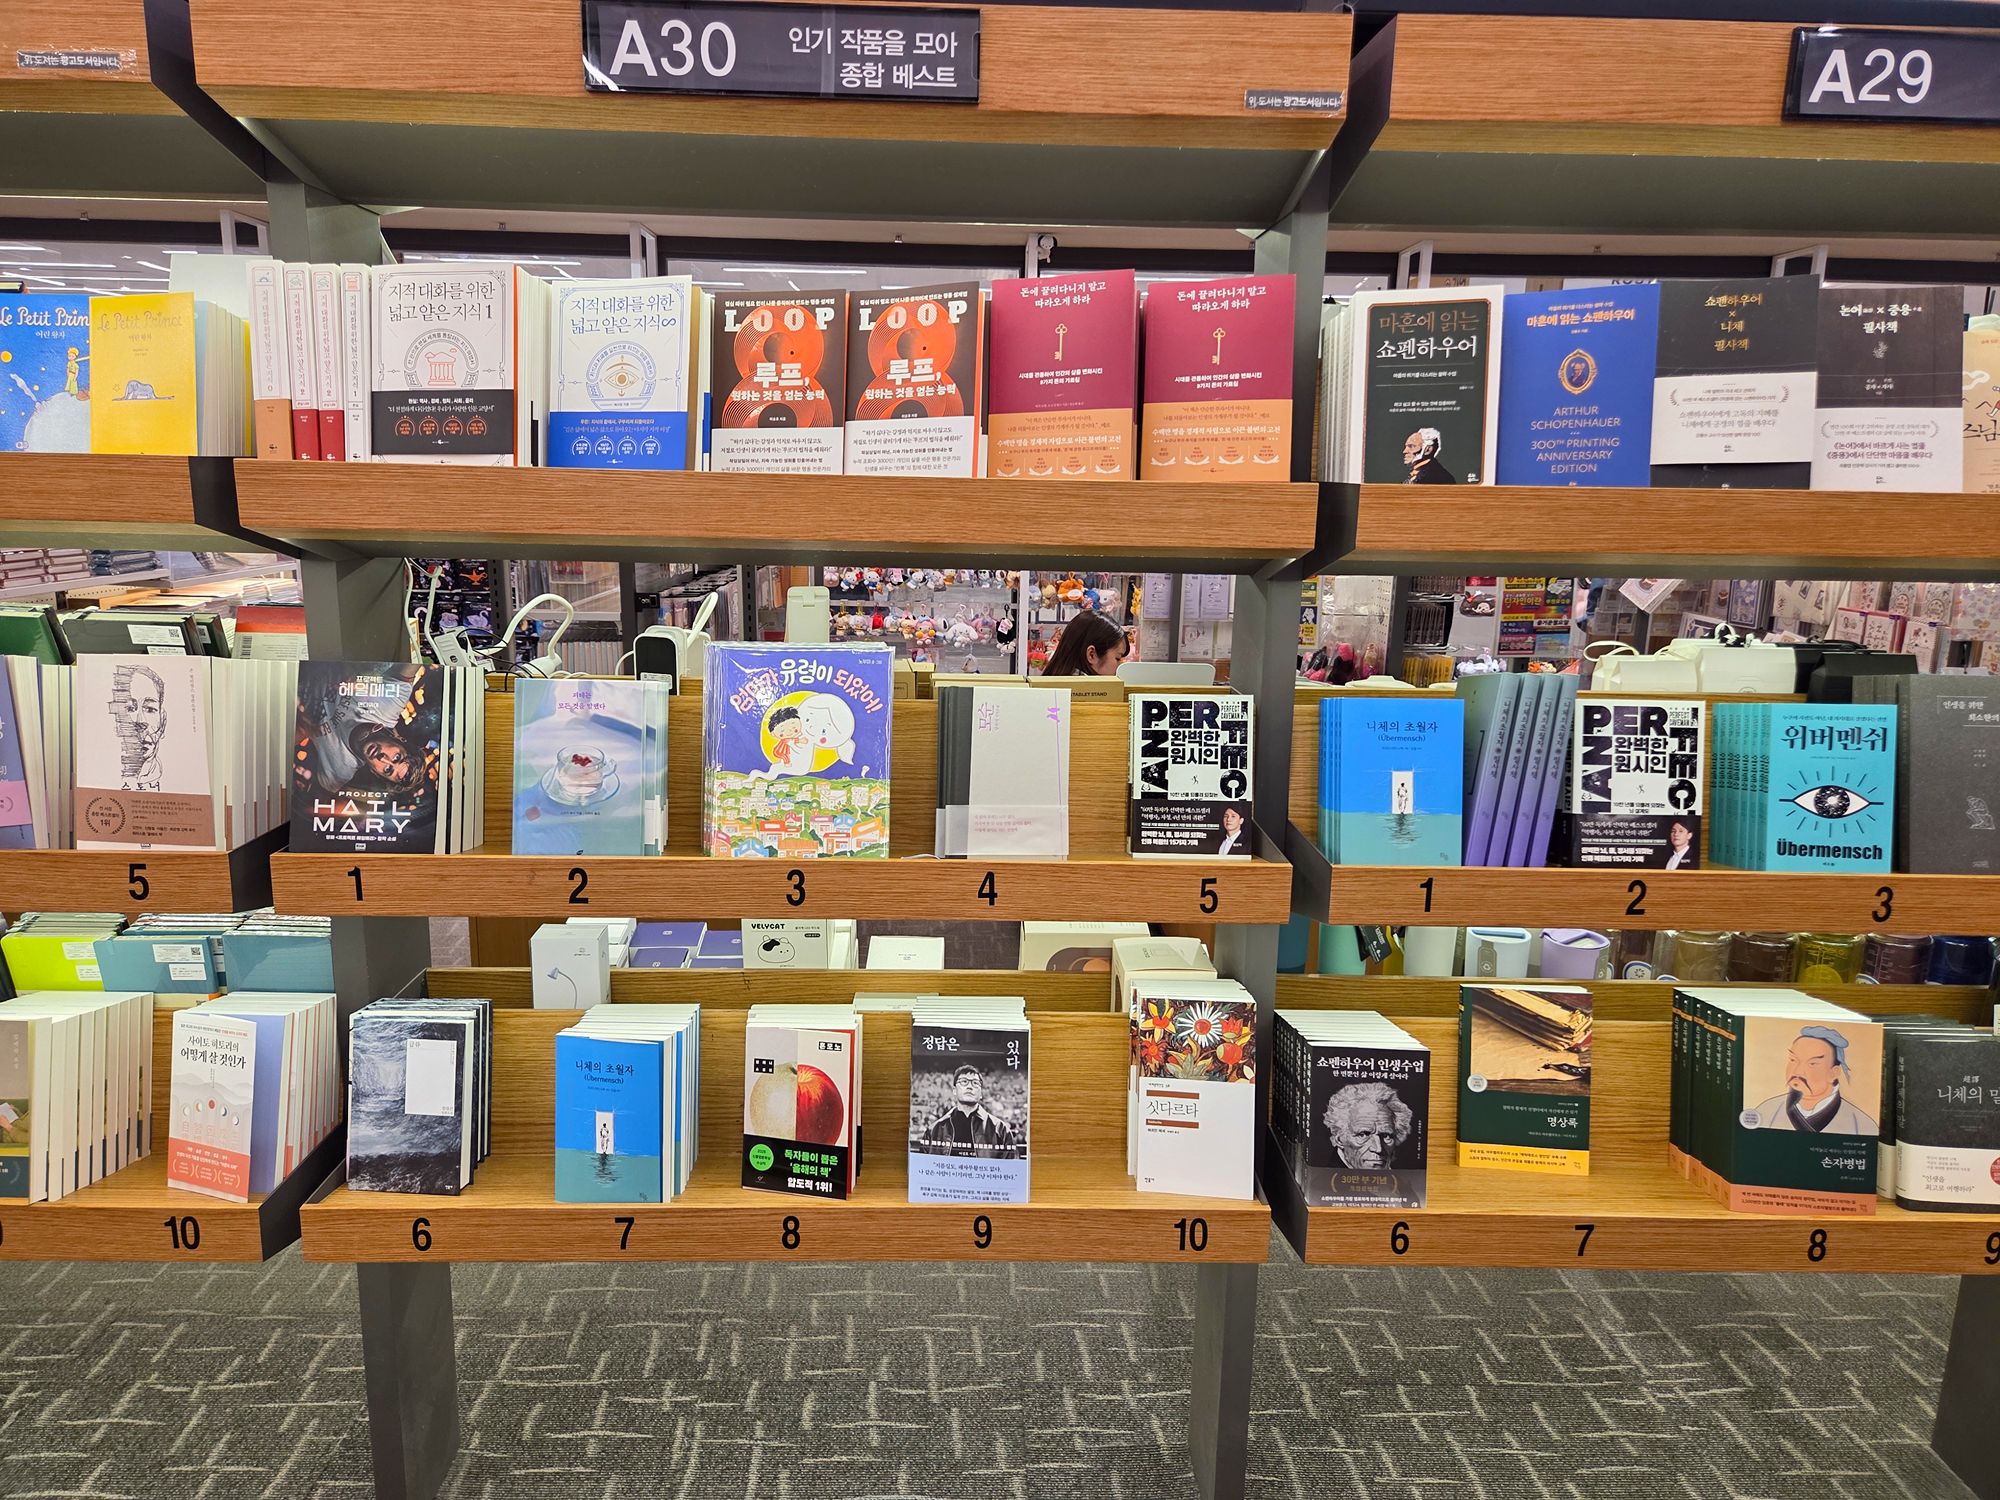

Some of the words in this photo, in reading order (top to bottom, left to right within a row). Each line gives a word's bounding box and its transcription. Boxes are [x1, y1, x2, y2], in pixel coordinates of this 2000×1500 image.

[609, 19, 737, 77] A30
[788, 27, 832, 54] 인기
[840, 27, 905, 56] 작품을
[913, 31, 957, 58] 모아
[840, 61, 884, 88] 종합
[892, 63, 957, 89] 베스트
[1808, 48, 1933, 104] A29
[389, 282, 416, 300] 지적
[419, 281, 464, 300] 대화를
[466, 281, 496, 300] 위한
[1020, 286, 1039, 298] 돈에
[1041, 282, 1086, 297] 끌려다니지
[1088, 281, 1107, 292] 말고
[1177, 290, 1196, 301] 돈에
[1198, 287, 1245, 300] 끌려다니지
[1247, 285, 1267, 297] 말고
[570, 297, 599, 315] 지적
[602, 296, 645, 314] 대화를
[646, 293, 675, 312] 위한
[1035, 296, 1071, 308] 따라오게
[1072, 294, 1091, 305] 하라
[1192, 301, 1229, 312] 따라오게
[1231, 298, 1251, 309] 하라
[1704, 294, 1763, 307] 쇼펜하우어
[1839, 304, 1863, 316] 논어
[1888, 304, 1912, 316] 중용
[17, 306, 51, 327] Petit
[389, 303, 418, 321] 넓고
[419, 303, 451, 322] 얕은
[452, 302, 481, 321] 지식
[485, 304, 493, 319] 1
[724, 307, 835, 332] LOOP
[859, 300, 968, 331] LOOP
[1526, 314, 1558, 327] 마흔에
[1560, 313, 1580, 325] 읽는
[1582, 308, 1636, 323] 쇼펜하우어
[571, 317, 601, 335] 넓고
[602, 316, 632, 335] 얕은
[633, 314, 661, 333] 지식
[1379, 311, 1436, 334] 마흔에
[1440, 310, 1479, 333] 읽는
[1720, 320, 1745, 333] 니체
[1863, 321, 1898, 334] 필사책
[35, 330, 51, 339] 어린
[51, 330, 65, 340] 왕자
[1376, 335, 1477, 360] 쇼펜하우어
[1714, 339, 1750, 351] 필사책
[753, 362, 810, 388] 루프,
[886, 358, 942, 386] 루프,
[731, 389, 761, 401] 원하는
[762, 389, 782, 401] 것을
[784, 389, 804, 401] 얻는
[805, 388, 825, 400] 능력
[865, 388, 893, 400] 원하는
[895, 386, 914, 398] 것을
[916, 385, 935, 397] 얻는
[936, 383, 957, 395] 능력
[1553, 406, 1599, 417] ARTHUR
[1530, 417, 1621, 431] SCHOPENHAUER
[1567, 437, 1620, 449] PRINTING
[1536, 450, 1613, 461] ANNIVERSARY
[1551, 463, 1598, 474] EDITION
[356, 675, 384, 683] 프로젝트
[780, 659, 834, 686] 유령이
[833, 668, 884, 714] 되었어!
[338, 682, 400, 698] 헤일메리
[1141, 700, 1220, 729] PER
[1943, 701, 1966, 710] 인생을
[1968, 701, 1984, 709] 위한
[1366, 720, 1400, 733] 니체의
[1405, 720, 1439, 734] 초월자
[1583, 705, 1668, 736] PER
[1170, 730, 1221, 747] 완벽한
[1377, 734, 1427, 743] (Übermensch)
[1614, 737, 1669, 754] 완벽한
[1781, 725, 1888, 752] 위버멘쉬
[1170, 748, 1219, 765] 원시인
[1614, 755, 1666, 773] 원시인
[121, 781, 161, 792] 스토너
[313, 799, 412, 817] HAIL
[100, 819, 111, 828] 1위
[313, 817, 412, 834] MARY
[1776, 839, 1883, 860] Übermensch
[128, 863, 150, 901] 5
[347, 866, 364, 902] 1
[568, 867, 589, 905] 2
[786, 869, 806, 907] 3
[977, 871, 998, 906] 4
[1199, 877, 1219, 914] 5
[1419, 877, 1434, 913] 1
[1625, 879, 1647, 916] 2
[1871, 886, 1894, 923] 3
[752, 922, 786, 930] VELYCAT
[188, 1036, 211, 1049] 사이토
[922, 1035, 960, 1051] 정답은
[180, 1047, 208, 1063] 어떻게
[208, 1052, 219, 1065] 살
[220, 1053, 247, 1070] 것인가
[1006, 1040, 1021, 1071] 있다
[1316, 1056, 1375, 1071] 쇼펜하우어
[1377, 1058, 1424, 1073] 인생수업
[575, 1060, 602, 1074] 니체의
[605, 1063, 635, 1077] 초월자
[584, 1075, 625, 1085] (Übermensch)
[1936, 1085, 1983, 1105] 니체의
[1146, 1100, 1200, 1118] 싯다르타
[1547, 1116, 1579, 1129] 명상록
[784, 1149, 819, 1163] 독자들이
[820, 1150, 839, 1166] 뽑은
[1820, 1156, 1867, 1171] 손자병법
[787, 1177, 814, 1191] 압도적
[814, 1181, 833, 1193] 1위!
[1341, 1175, 1361, 1184] 30만
[1361, 1176, 1370, 1184] 부
[1371, 1176, 1388, 1185] 기념
[163, 1215, 201, 1250] 10
[412, 1217, 432, 1252] 6
[614, 1216, 635, 1250] 7
[781, 1215, 801, 1250] 8
[973, 1215, 993, 1249] 9
[1173, 1217, 1208, 1252] 10
[1390, 1221, 1410, 1255] 6
[1574, 1224, 1595, 1257] 7
[1807, 1228, 1828, 1263] 8
[1984, 1231, 2000, 1265] 9
